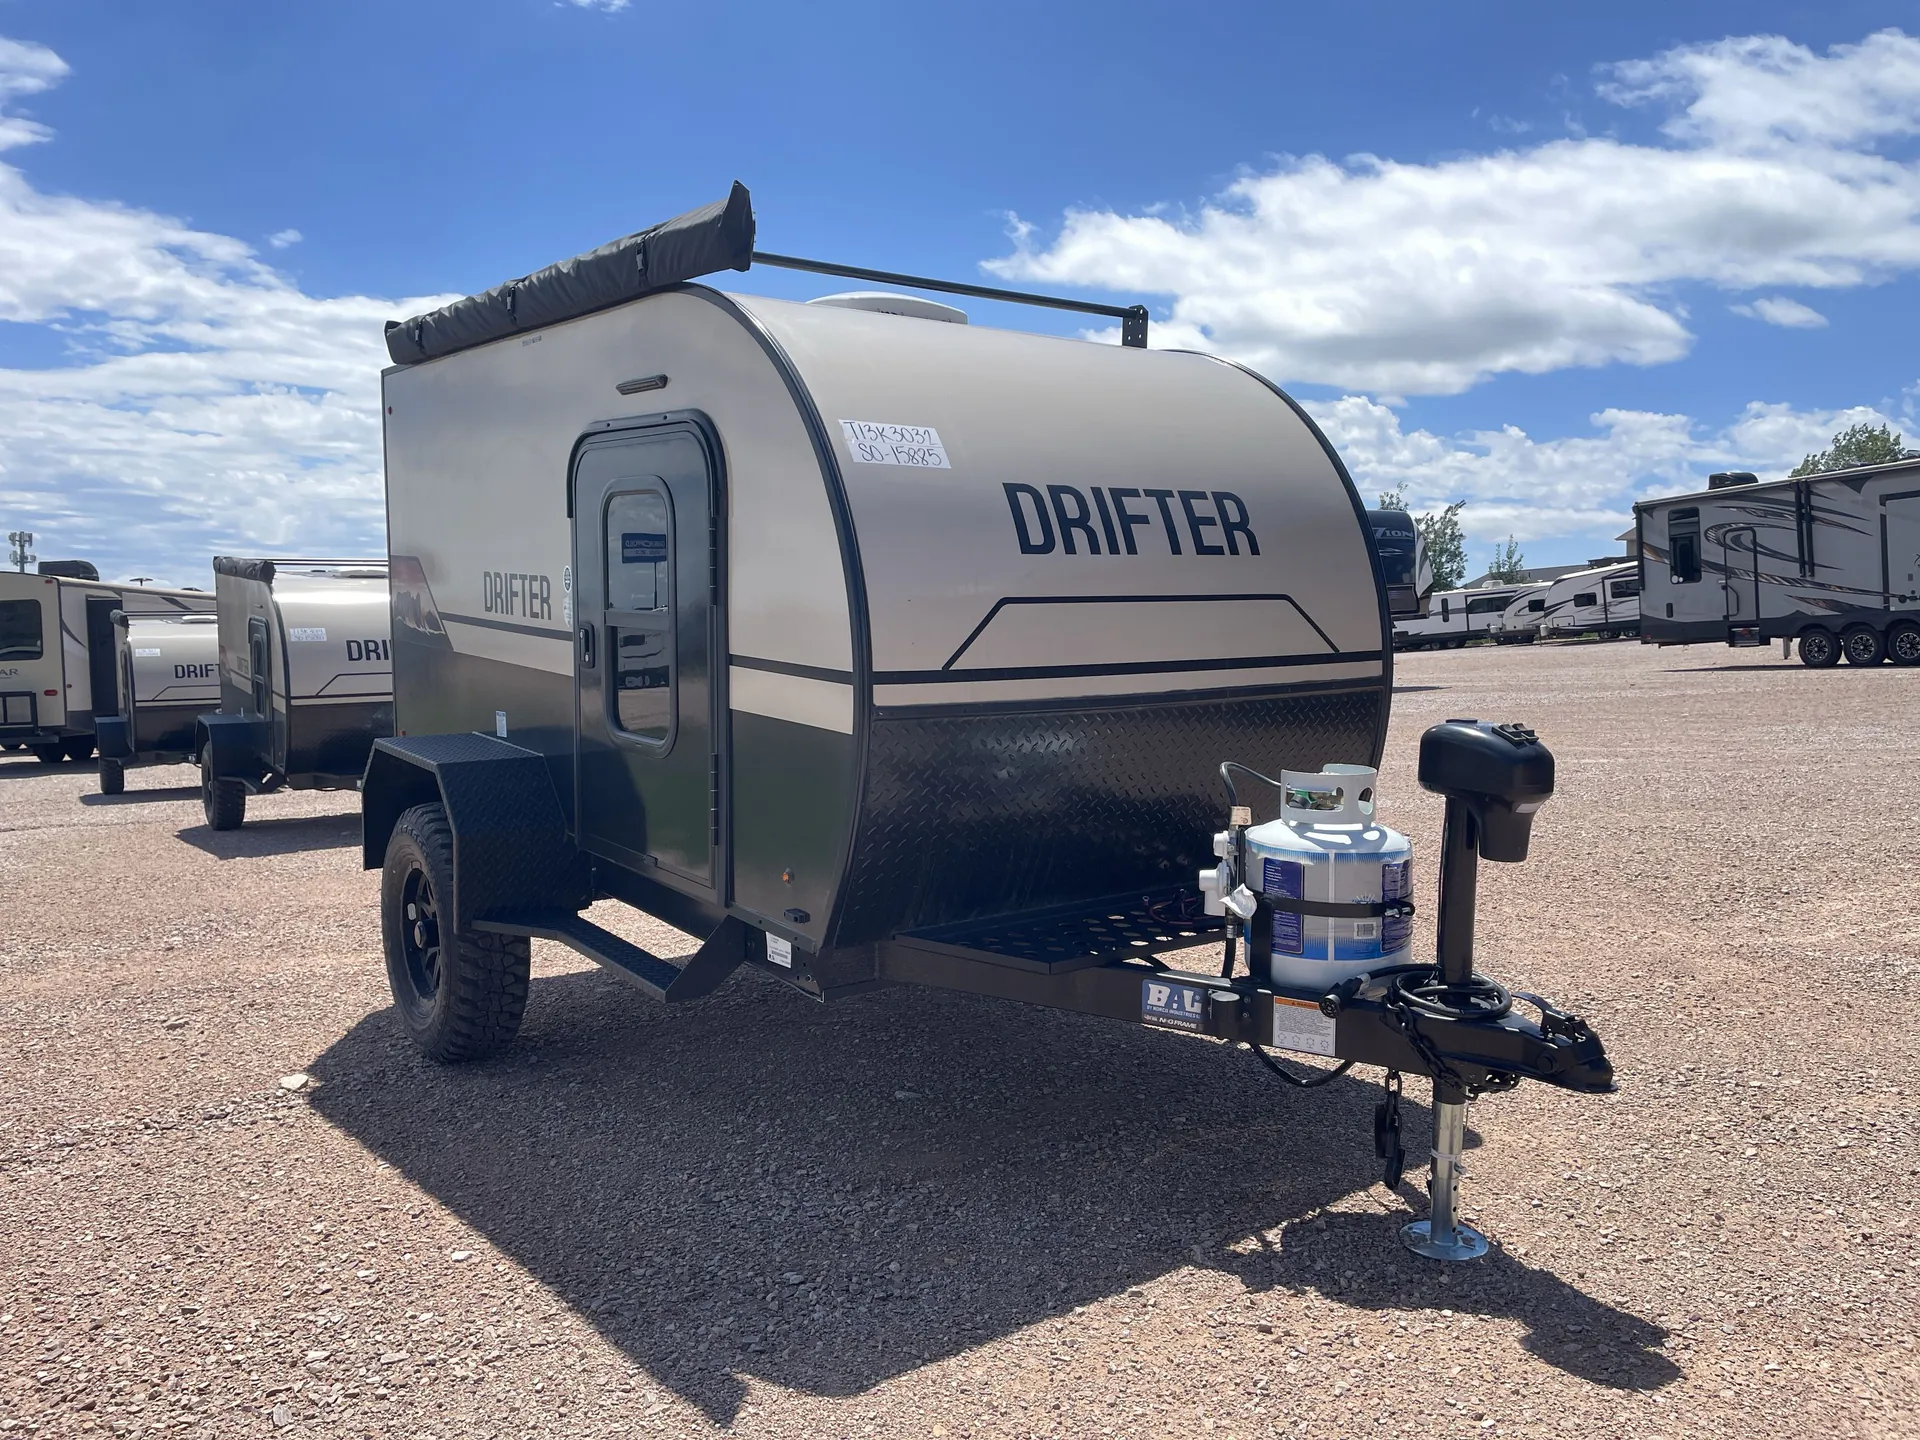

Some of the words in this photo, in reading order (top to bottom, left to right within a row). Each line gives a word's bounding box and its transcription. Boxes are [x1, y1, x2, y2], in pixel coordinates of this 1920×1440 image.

[857, 442, 943, 466] SO-15885
[1002, 482, 1261, 556] DRIFTER
[483, 570, 552, 621] DRIFTER
[345, 639, 392, 662] DRI
